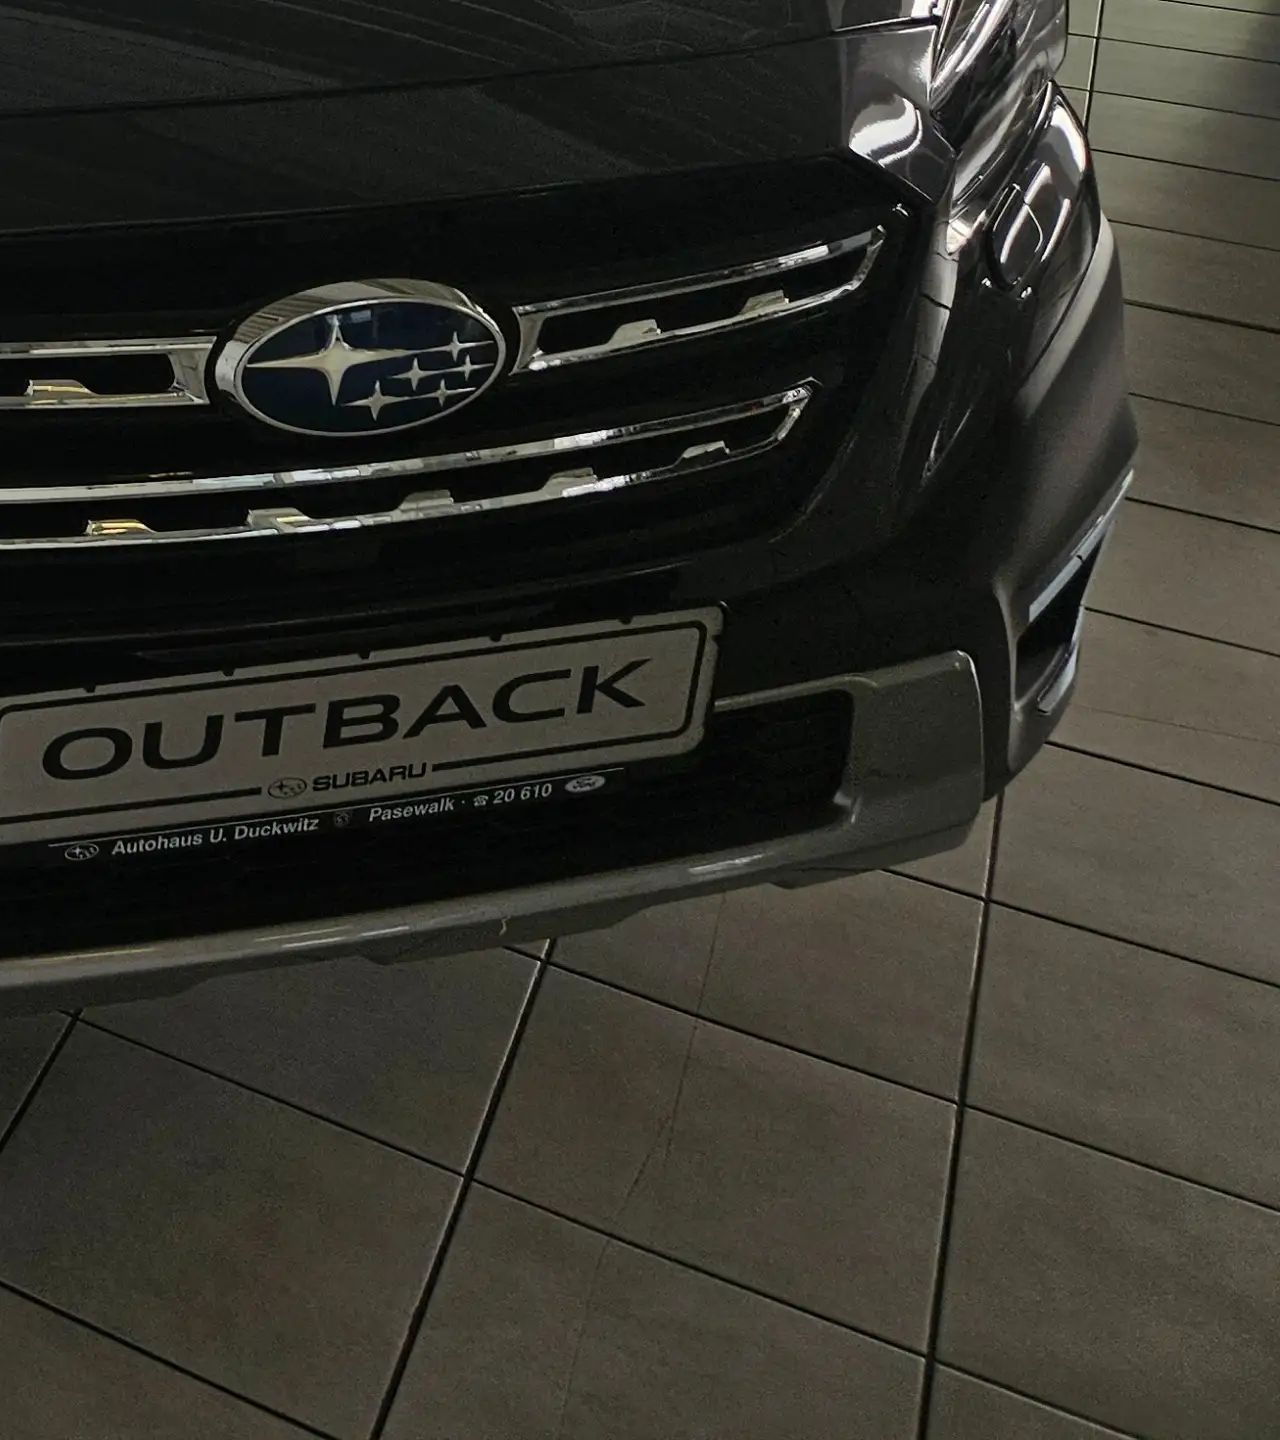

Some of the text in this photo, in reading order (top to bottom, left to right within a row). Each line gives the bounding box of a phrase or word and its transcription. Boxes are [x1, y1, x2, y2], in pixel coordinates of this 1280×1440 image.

[40, 657, 653, 781] OUTBACK
[312, 762, 427, 792] SUBARU
[111, 830, 203, 857] Autohaus
[209, 828, 228, 844] U.
[234, 818, 320, 841] Duckwitz
[368, 797, 455, 823] Pasewalk
[492, 788, 516, 805] 20
[520, 783, 553, 801] 610
